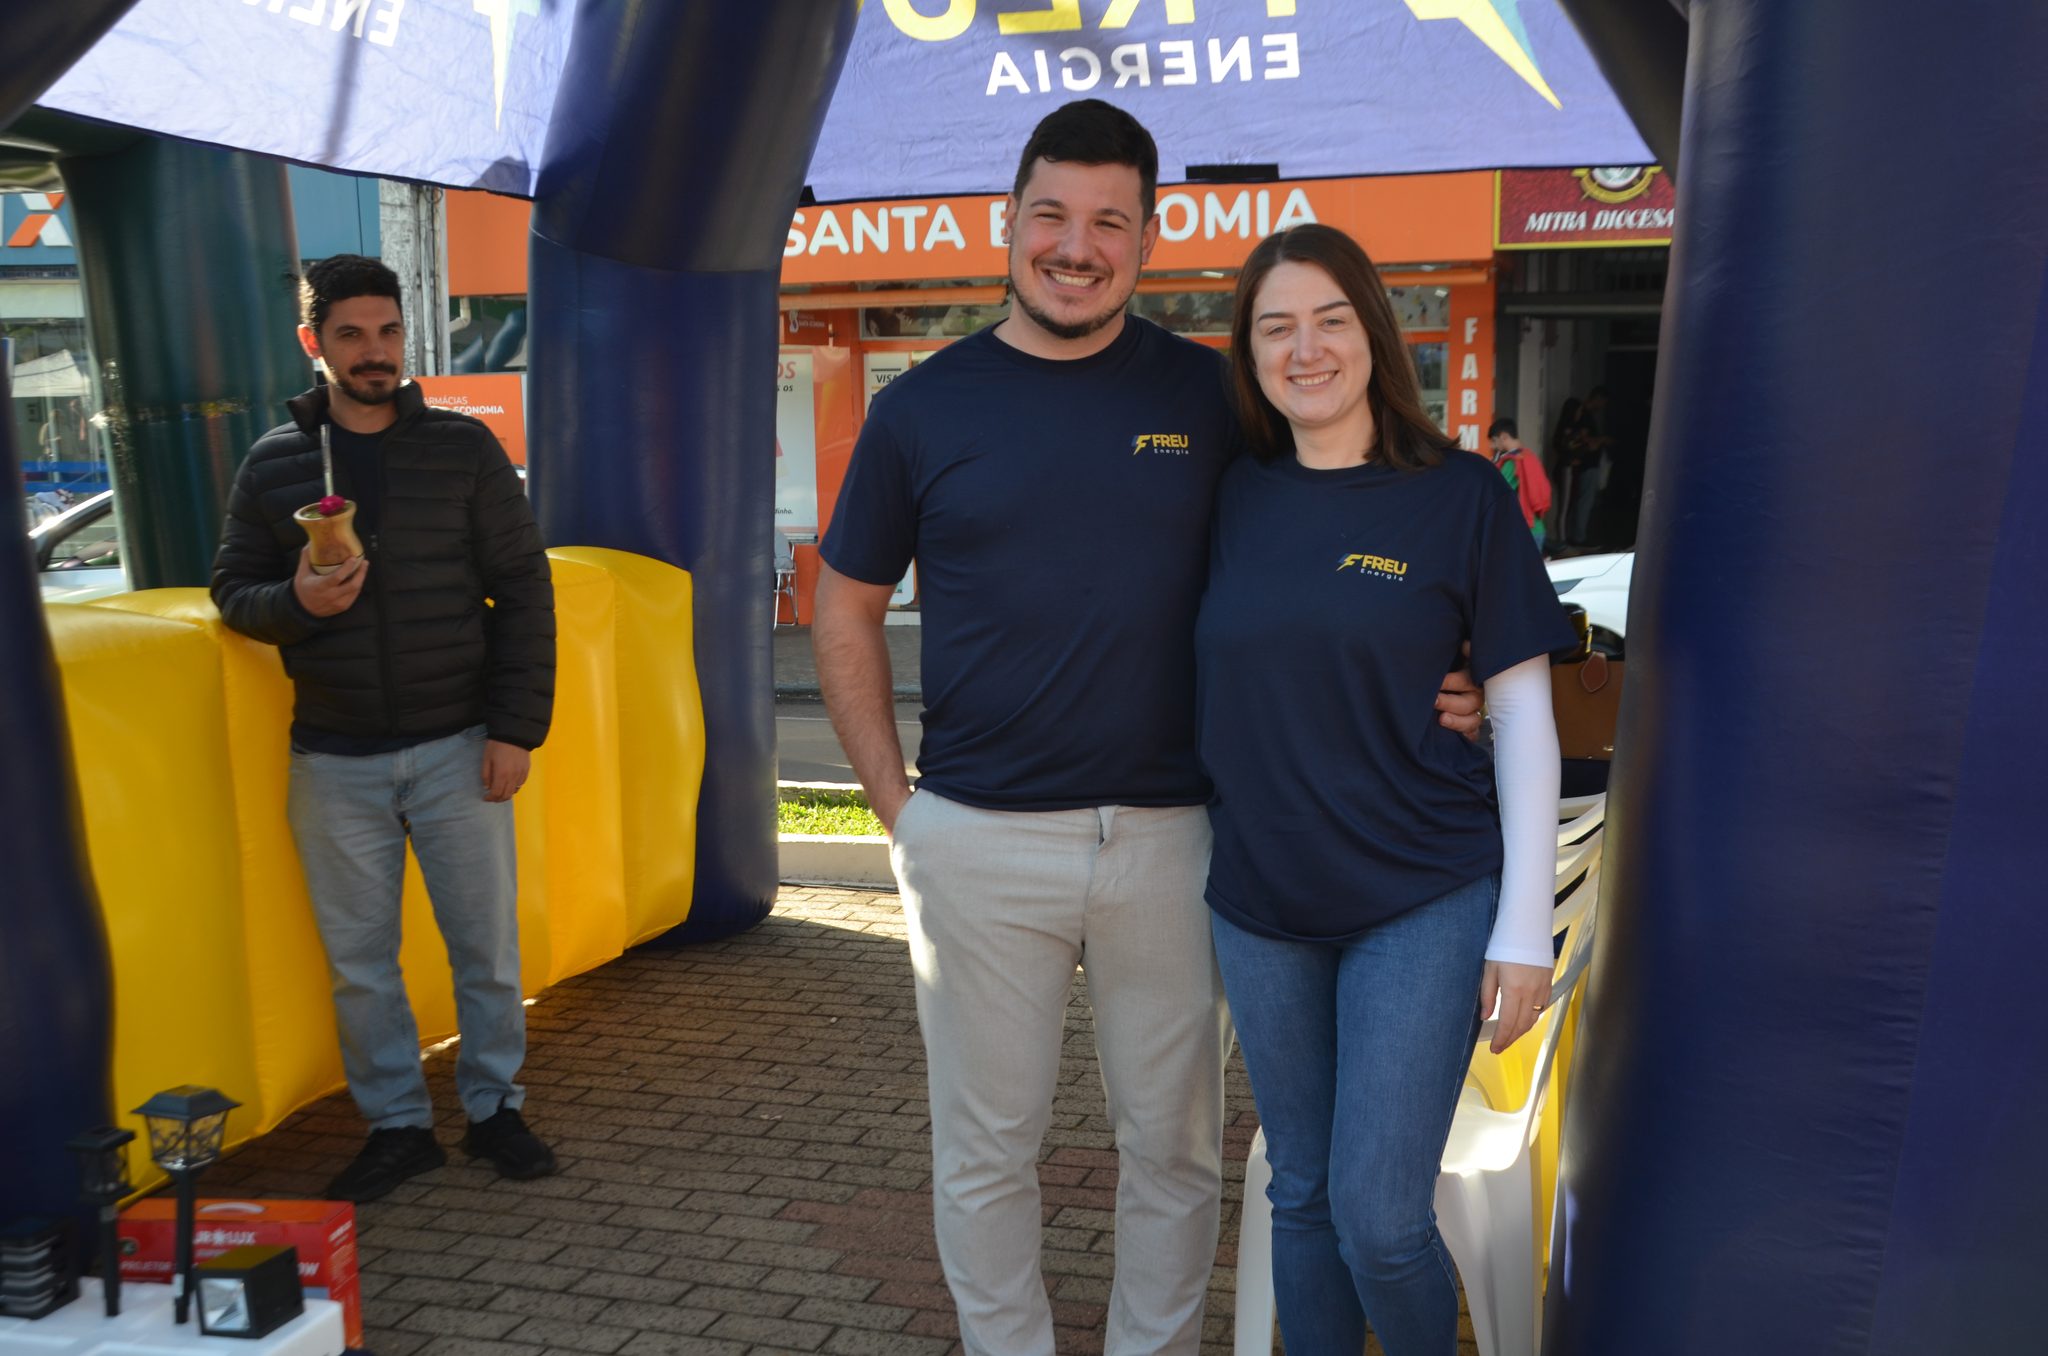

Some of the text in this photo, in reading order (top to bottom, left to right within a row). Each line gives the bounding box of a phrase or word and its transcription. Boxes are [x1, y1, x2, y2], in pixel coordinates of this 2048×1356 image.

[1524, 207, 1675, 233] MITRA DIOCESA
[784, 203, 966, 258] SANTA
[424, 396, 468, 406] ARMÁCIAS
[1151, 434, 1189, 448] FREU
[1154, 448, 1189, 456] Energia
[1362, 554, 1408, 575] FREU
[1360, 567, 1404, 582] Energia
